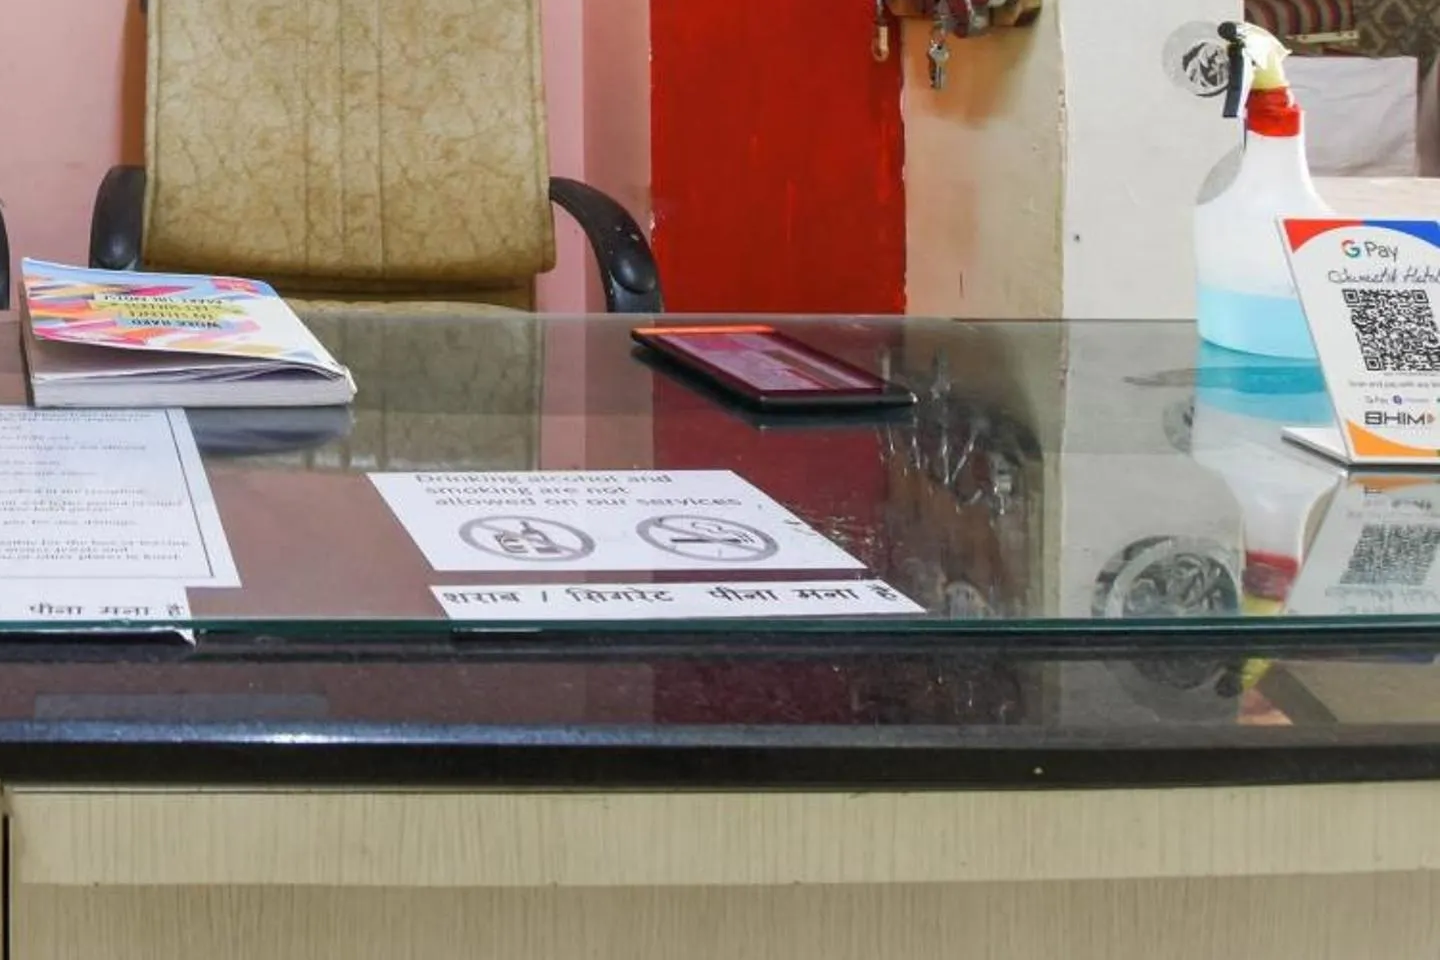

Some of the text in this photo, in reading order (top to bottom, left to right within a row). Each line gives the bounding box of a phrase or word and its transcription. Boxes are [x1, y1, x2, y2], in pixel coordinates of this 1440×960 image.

[1363, 241, 1398, 262] Pay
[1364, 410, 1426, 426] BHIM
[416, 473, 674, 485] Drinking alcohol and
[425, 486, 629, 497] smoking are not
[435, 497, 743, 508] allowed on our services
[441, 588, 521, 604] शराब
[706, 586, 780, 603] पीना
[792, 587, 860, 602] मना
[871, 583, 900, 602] है
[98, 603, 151, 617] मना
[164, 600, 184, 617] है
